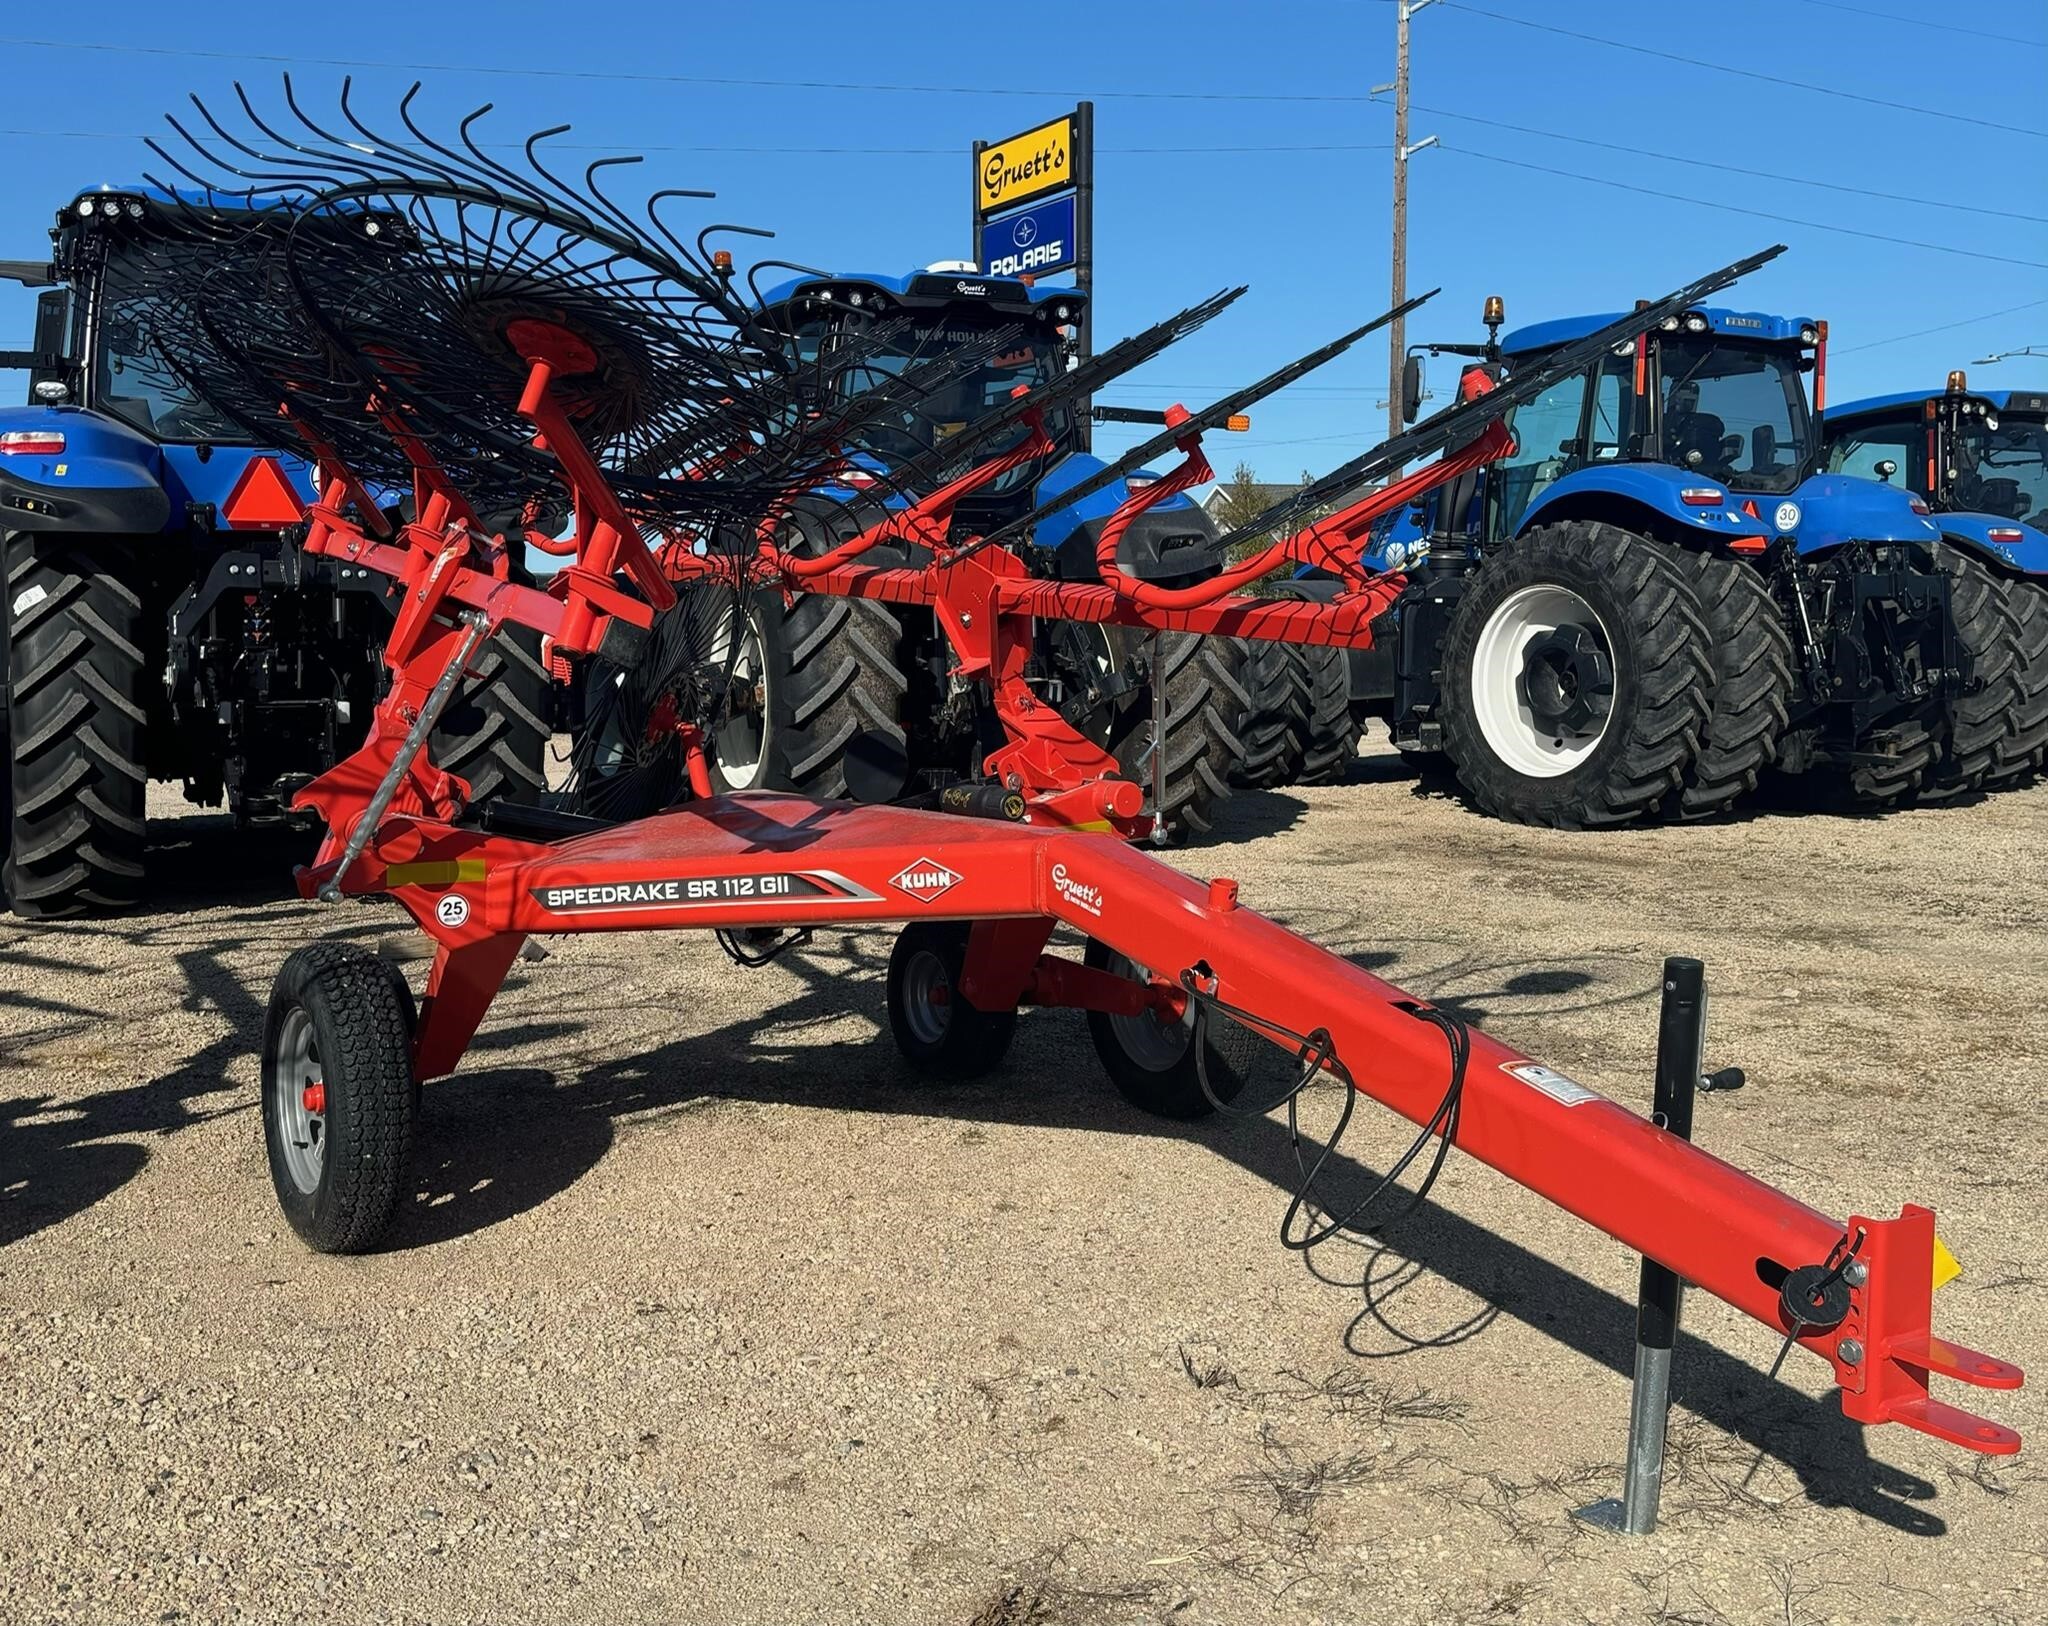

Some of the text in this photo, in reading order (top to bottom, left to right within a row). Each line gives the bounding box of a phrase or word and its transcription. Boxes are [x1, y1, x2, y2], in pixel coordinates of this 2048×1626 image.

[984, 138, 1065, 199] Gruett's
[990, 240, 1062, 277] POLARIS
[1780, 508, 1796, 521] 30
[547, 876, 789, 906] SPEEDRAKE SR 112 GII
[901, 871, 951, 889] KUHN
[1052, 863, 1103, 908] Gruett's
[443, 901, 463, 916] 25
